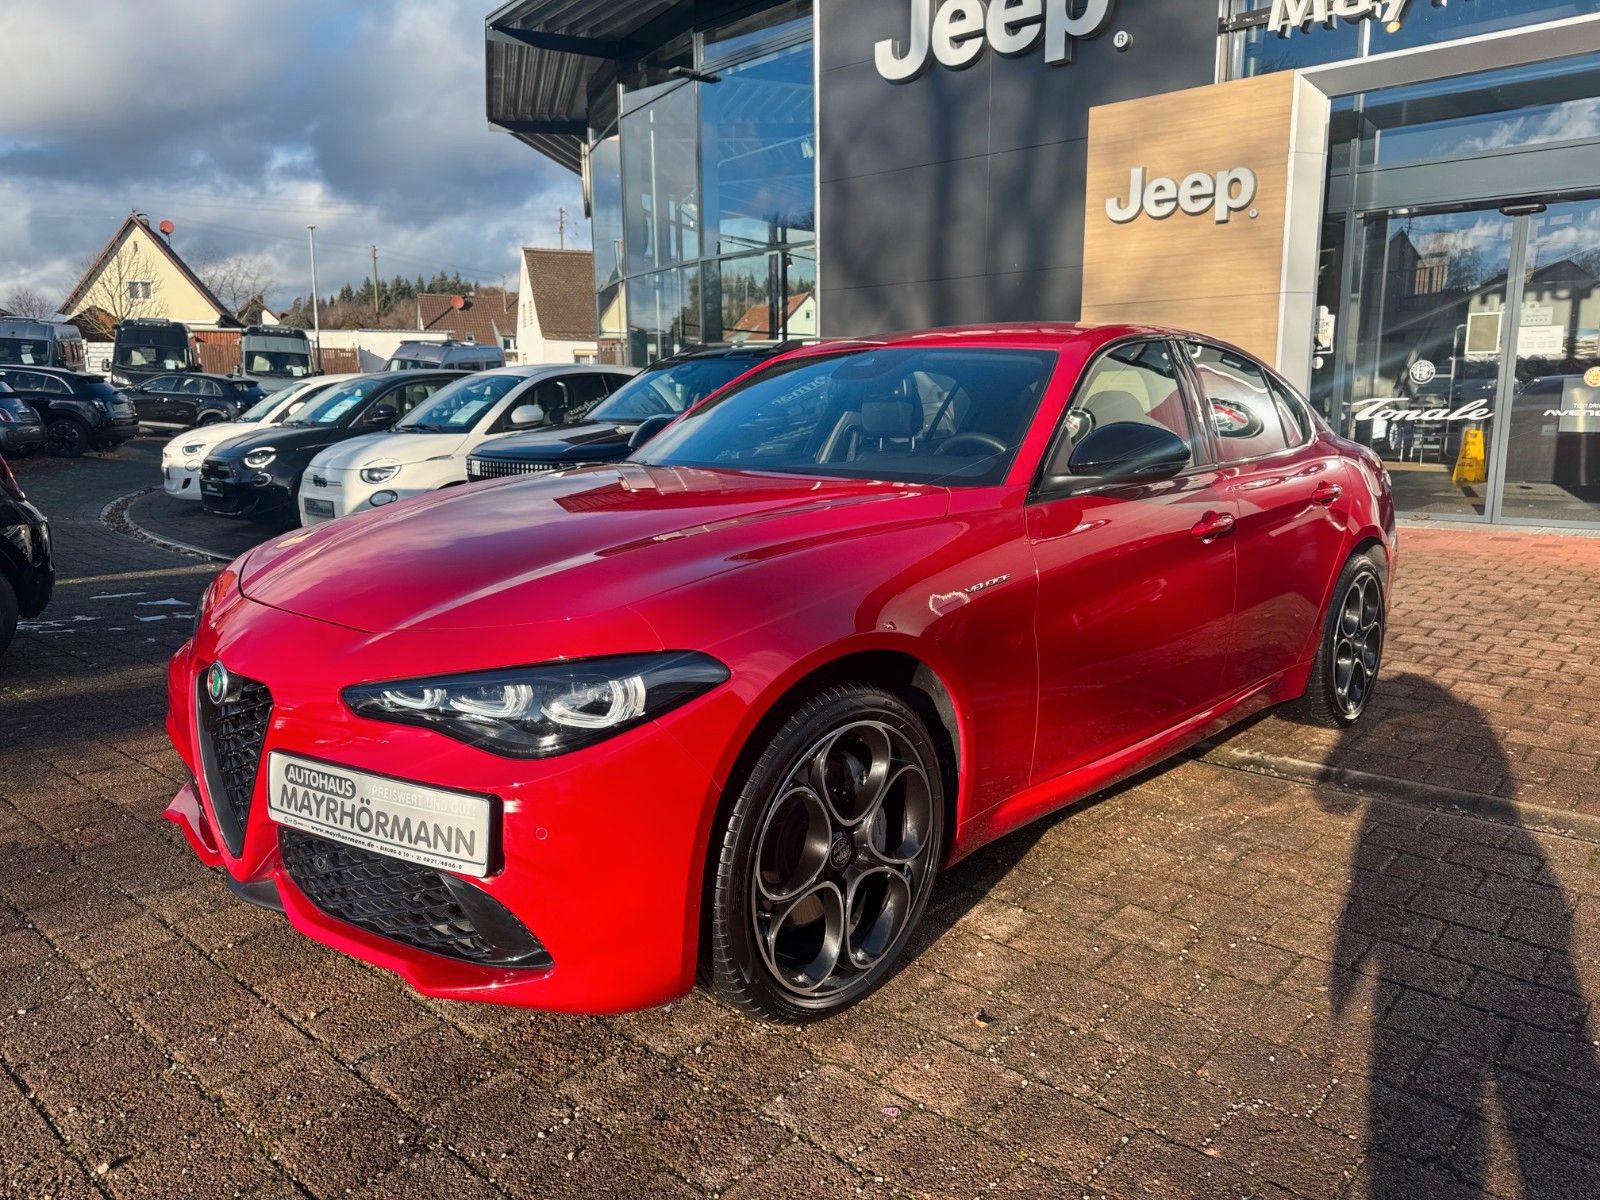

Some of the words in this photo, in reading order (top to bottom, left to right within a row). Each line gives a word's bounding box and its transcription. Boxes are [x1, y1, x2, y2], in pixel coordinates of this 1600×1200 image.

[875, 0, 1113, 81] Jeep
[1105, 166, 1257, 223] Jeep
[1353, 397, 1495, 422] Tonale
[287, 765, 353, 797] AUTOHAUS
[371, 785, 422, 806] PREISWERT
[280, 783, 476, 857] MAYRHÖRMANN
